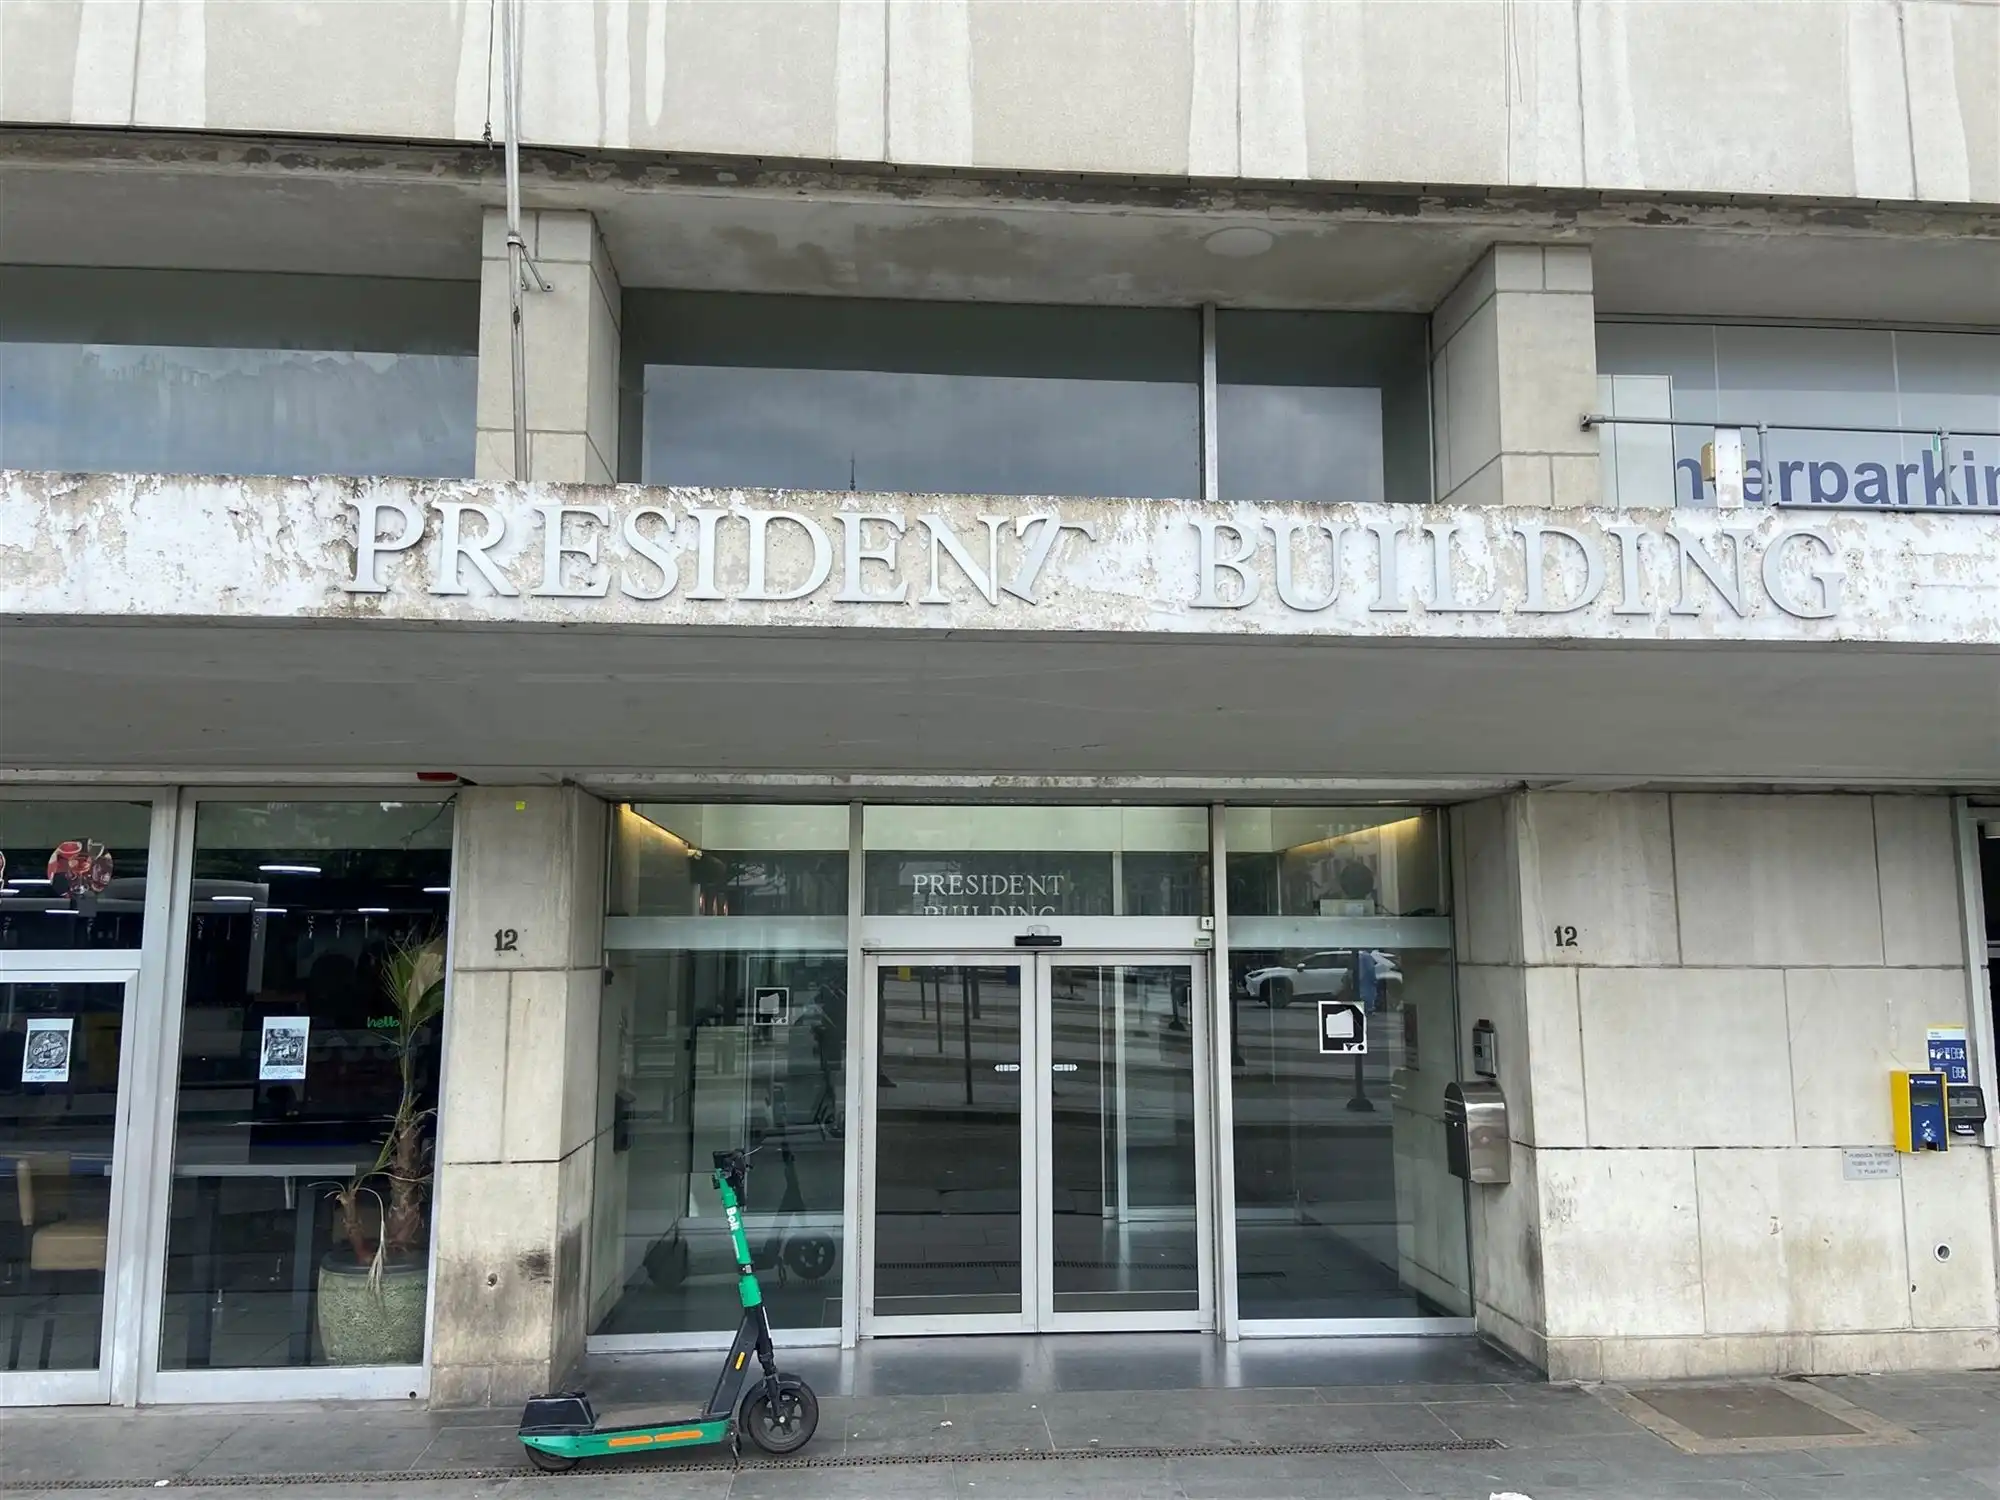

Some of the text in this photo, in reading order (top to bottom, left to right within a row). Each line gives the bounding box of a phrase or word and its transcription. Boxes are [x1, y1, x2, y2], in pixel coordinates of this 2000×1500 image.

[343, 499, 1846, 619] PRESIDENT BUILDING
[912, 874, 1064, 896] PRESIDENT
[494, 928, 518, 951] 12
[1554, 925, 1578, 947] 12
[726, 1206, 740, 1231] Bolt
